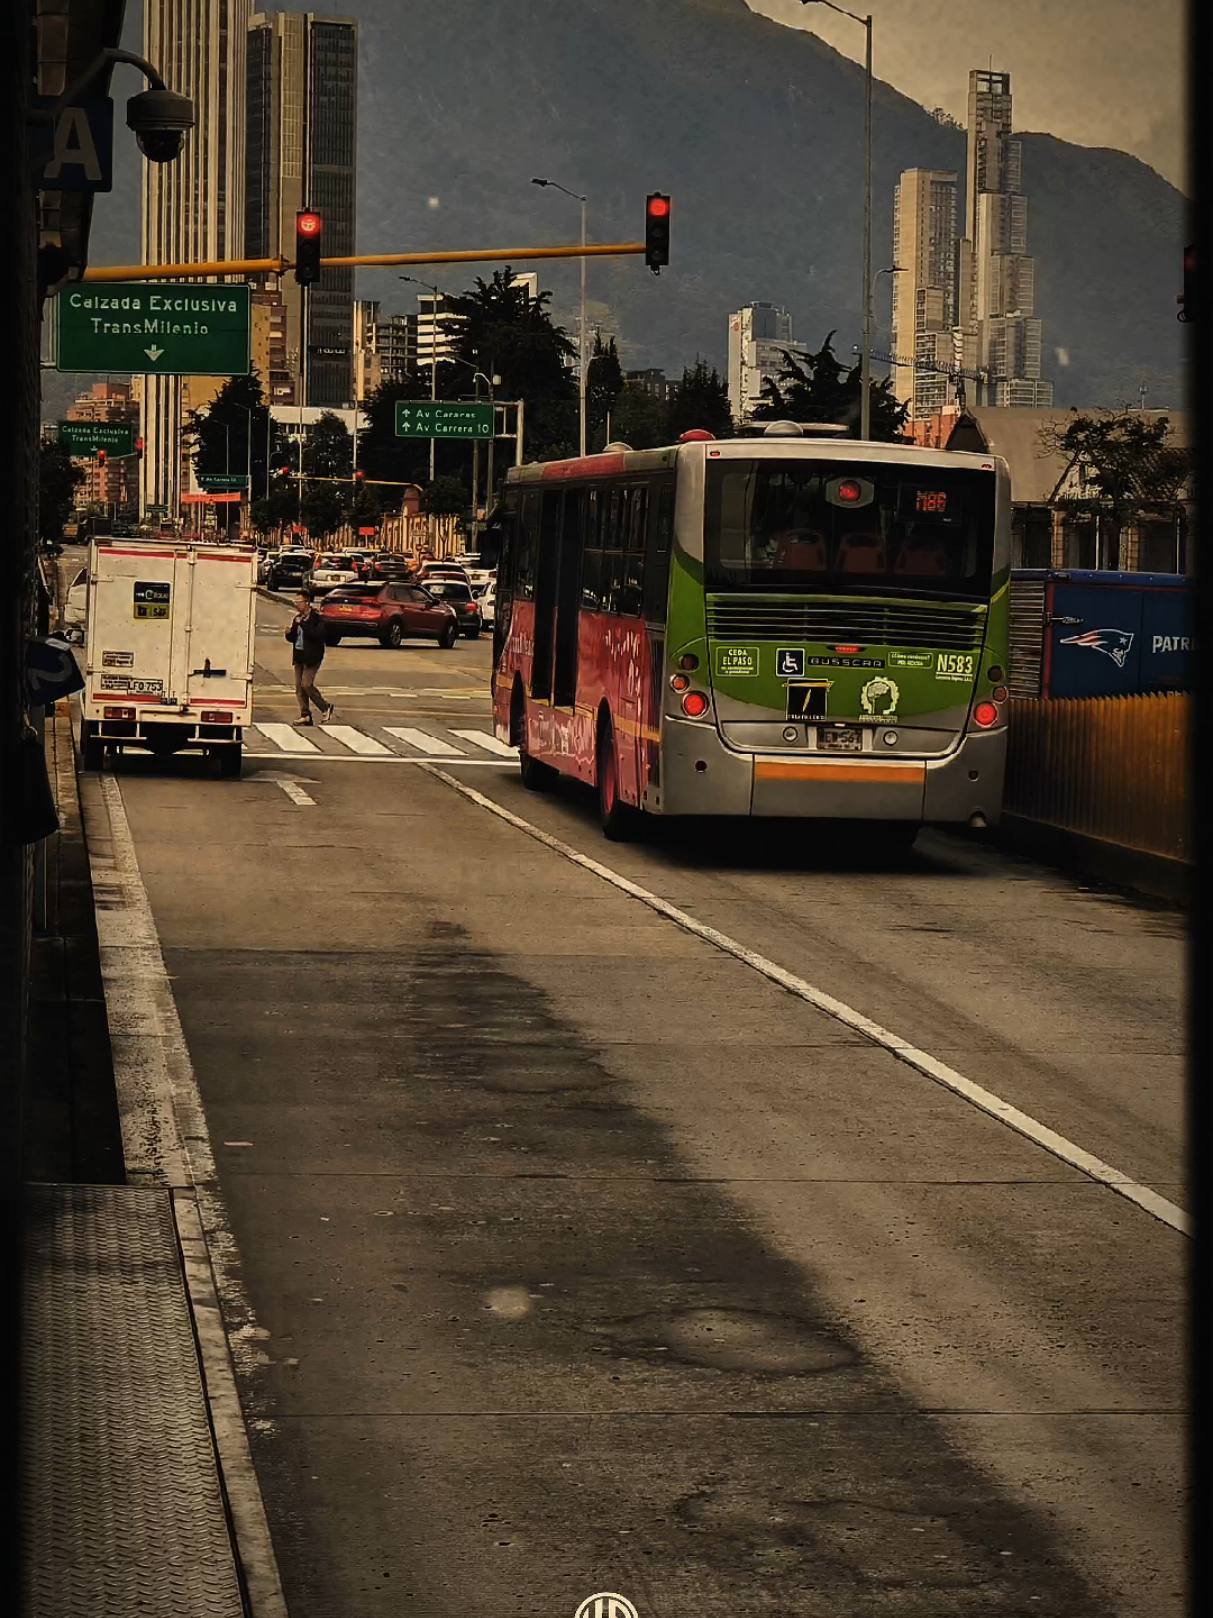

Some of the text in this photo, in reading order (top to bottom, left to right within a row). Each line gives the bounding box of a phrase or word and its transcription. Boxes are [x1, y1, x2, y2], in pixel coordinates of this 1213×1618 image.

[43, 107, 103, 181] A
[69, 293, 141, 309] Calzada
[149, 295, 237, 312] Exclusiva
[90, 318, 209, 335] TransMilenio
[416, 409, 430, 418] Av
[62, 425, 129, 435] Calzada Exclusiva
[416, 422, 490, 433] Av Carrera 10
[71, 434, 119, 444] TransMilenio
[728, 648, 748, 656] CEDA
[722, 656, 753, 666] EL PASO
[937, 653, 973, 674] N583
[27, 652, 73, 691] 2
[145, 682, 163, 692] 753
